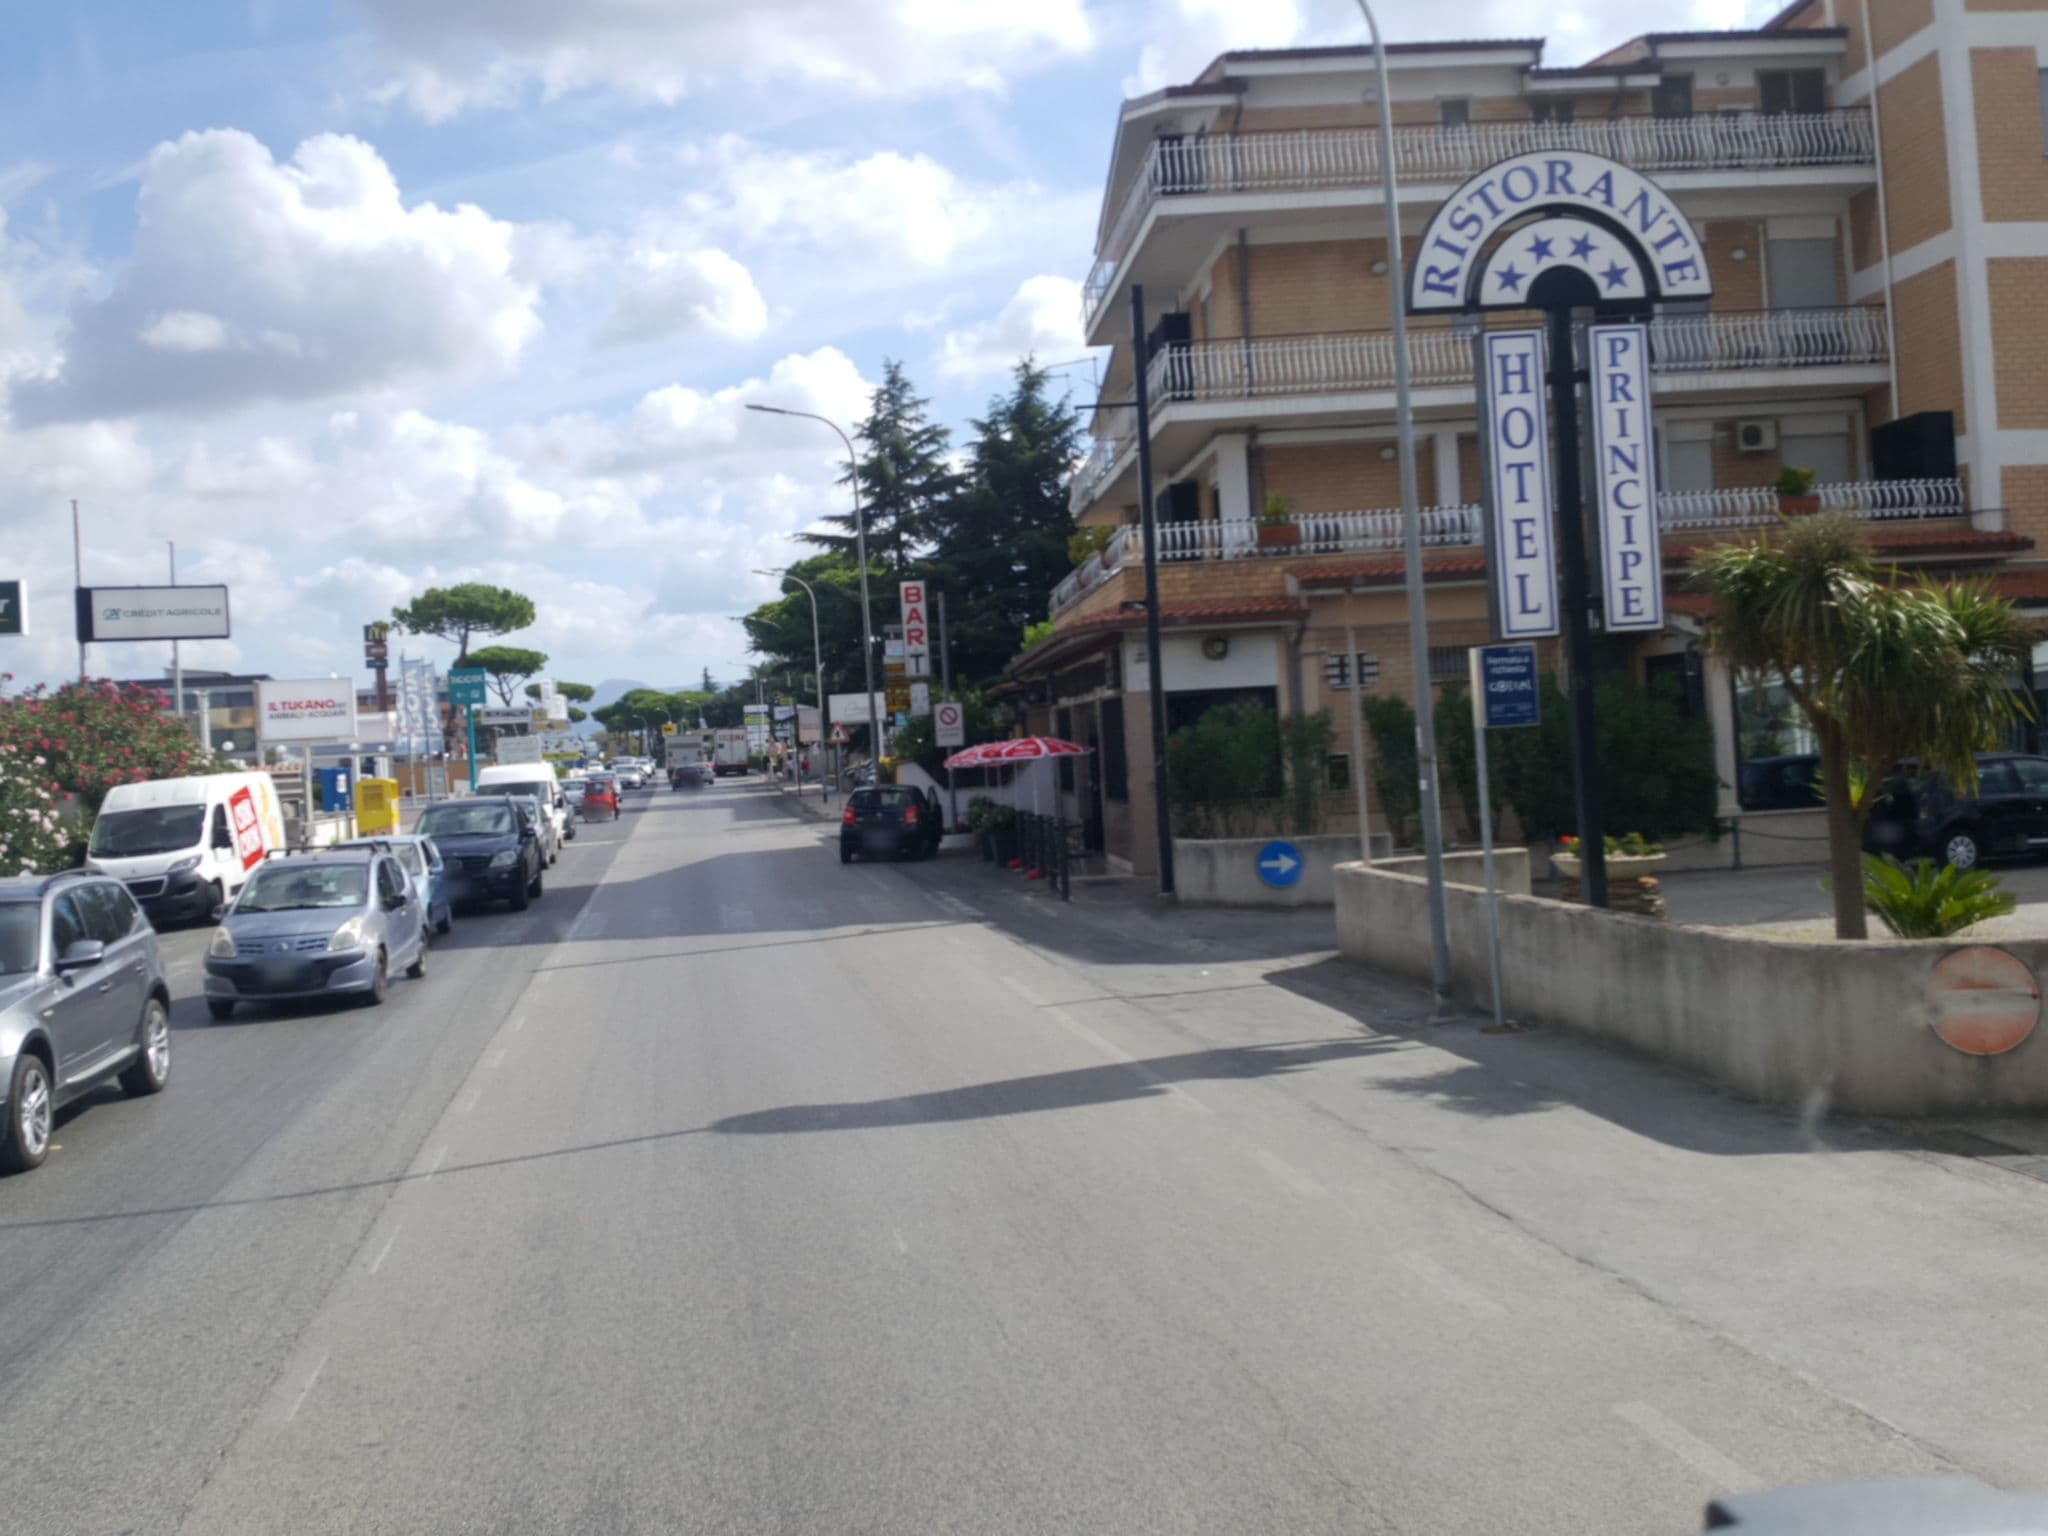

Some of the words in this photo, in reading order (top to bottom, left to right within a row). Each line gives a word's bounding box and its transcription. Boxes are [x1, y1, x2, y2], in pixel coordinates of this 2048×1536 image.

[1421, 158, 1702, 298] RISTORANTE
[1496, 351, 1543, 617] HOTEL
[1605, 335, 1646, 617] PRINCIPE
[903, 586, 925, 646] BAR
